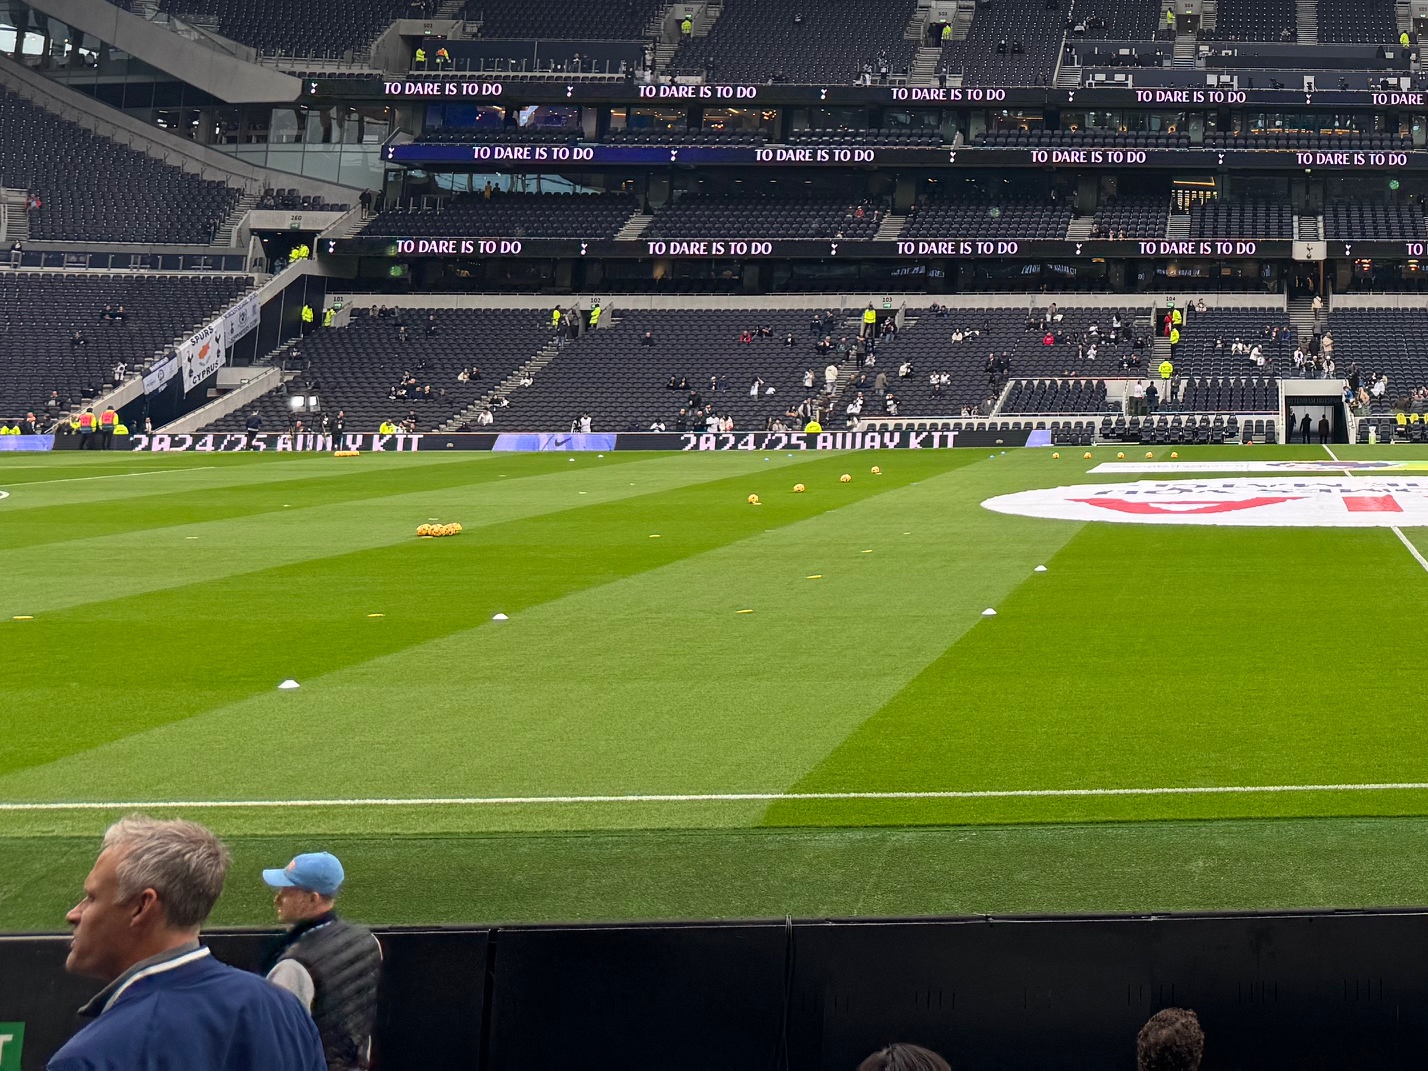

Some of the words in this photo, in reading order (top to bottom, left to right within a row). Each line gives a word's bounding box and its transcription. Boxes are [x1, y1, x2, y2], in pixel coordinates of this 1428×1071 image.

[383, 81, 402, 95] TO
[404, 82, 442, 95] DARE
[444, 82, 458, 96] IS
[460, 82, 479, 96] TO
[481, 83, 503, 96] DO
[638, 85, 657, 98] TO
[659, 85, 697, 98] DARE
[699, 85, 712, 98] IS
[714, 85, 734, 99] TO
[736, 86, 757, 99] DO
[890, 87, 909, 100] TO
[911, 88, 948, 101] DARE
[950, 88, 963, 101] IS
[965, 88, 983, 101] TO
[986, 88, 1006, 101] DO
[1135, 90, 1153, 103] TO
[1155, 90, 1190, 103] DARE
[1193, 90, 1205, 103] IS
[1207, 90, 1225, 103] TO
[1227, 91, 1247, 104] DO
[1371, 93, 1388, 105] TO
[1390, 93, 1425, 105] DARE
[472, 146, 491, 160] TO
[494, 146, 532, 160] DARE
[534, 146, 548, 160] IS
[551, 147, 570, 160] TO
[572, 147, 594, 161] DO
[754, 148, 774, 162] TO
[776, 148, 814, 162] DARE
[816, 149, 830, 162] IS
[832, 149, 851, 162] TO
[854, 149, 875, 162] DO
[1030, 150, 1048, 163] TO
[1052, 150, 1088, 163] DARE
[1091, 150, 1103, 163] IS
[1106, 150, 1124, 164] TO
[1126, 151, 1147, 164] DO
[396, 239, 415, 253] TO
[418, 239, 457, 254] DARE
[460, 240, 474, 254] IS
[477, 240, 497, 254] TO
[500, 240, 522, 255] DO
[647, 241, 667, 255] TO
[669, 241, 709, 255] DARE
[711, 241, 725, 255] IS
[728, 241, 748, 255] TO
[750, 241, 773, 255] DO
[896, 241, 915, 255] TO
[918, 241, 956, 255] DARE
[959, 241, 972, 255] IS
[975, 241, 994, 255] TO
[997, 241, 1018, 255] DO
[1138, 241, 1157, 255] TO
[1160, 241, 1197, 255] DARE
[1199, 241, 1212, 255] IS
[1214, 241, 1233, 255] TO
[1236, 241, 1256, 255] DO
[1405, 243, 1424, 256] TO
[190, 325, 214, 346] SPURS
[192, 361, 219, 384] CYPRUS
[132, 434, 266, 451] 2024/25
[372, 434, 424, 451] KIT
[680, 432, 808, 451] 2024/25
[816, 432, 900, 450] AWAY
[909, 431, 959, 449] KIT
